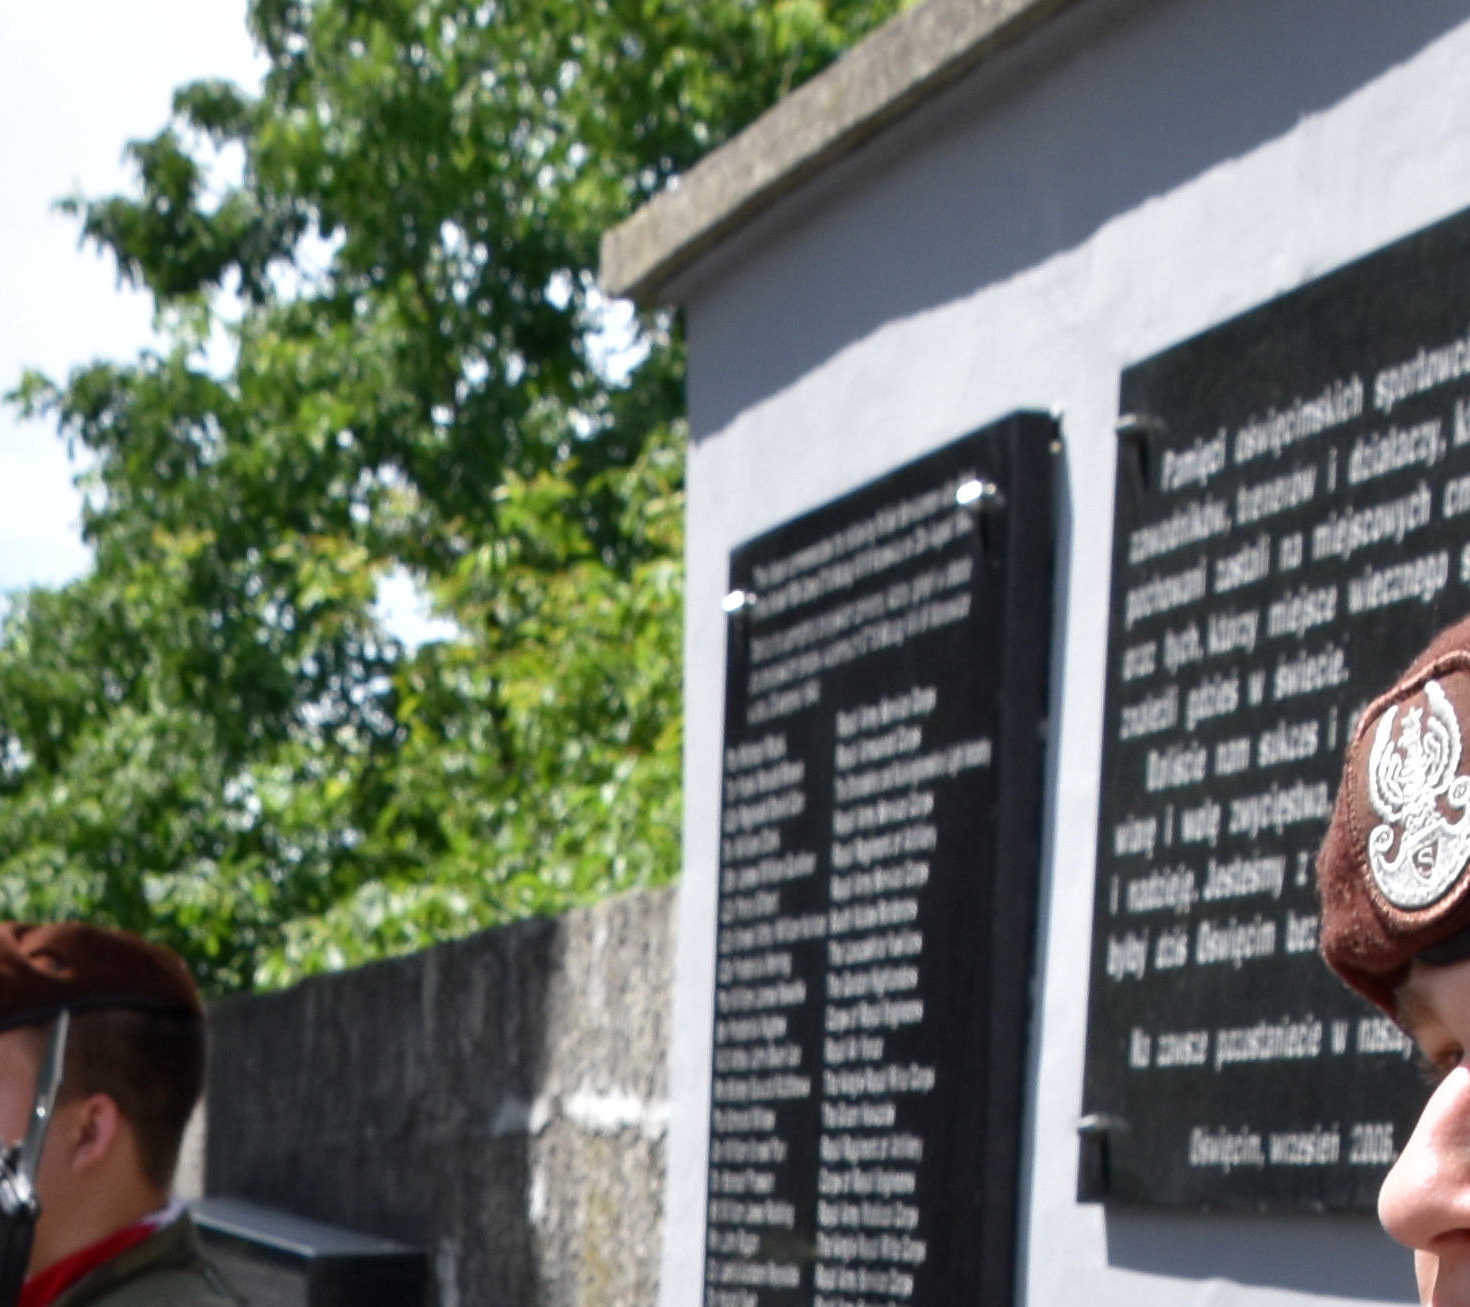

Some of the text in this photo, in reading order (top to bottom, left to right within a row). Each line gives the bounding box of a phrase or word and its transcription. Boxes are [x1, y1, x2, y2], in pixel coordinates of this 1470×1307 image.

[1327, 448, 1337, 490] i
[1267, 585, 1337, 637] miejsce
[1248, 671, 1265, 705] w
[1214, 737, 1250, 775] nam
[1327, 707, 1337, 749] i
[1164, 805, 1172, 845] i
[1416, 845, 1435, 877] S
[1110, 877, 1118, 913] i
[1295, 851, 1308, 886] z
[1331, 1021, 1347, 1054] w
